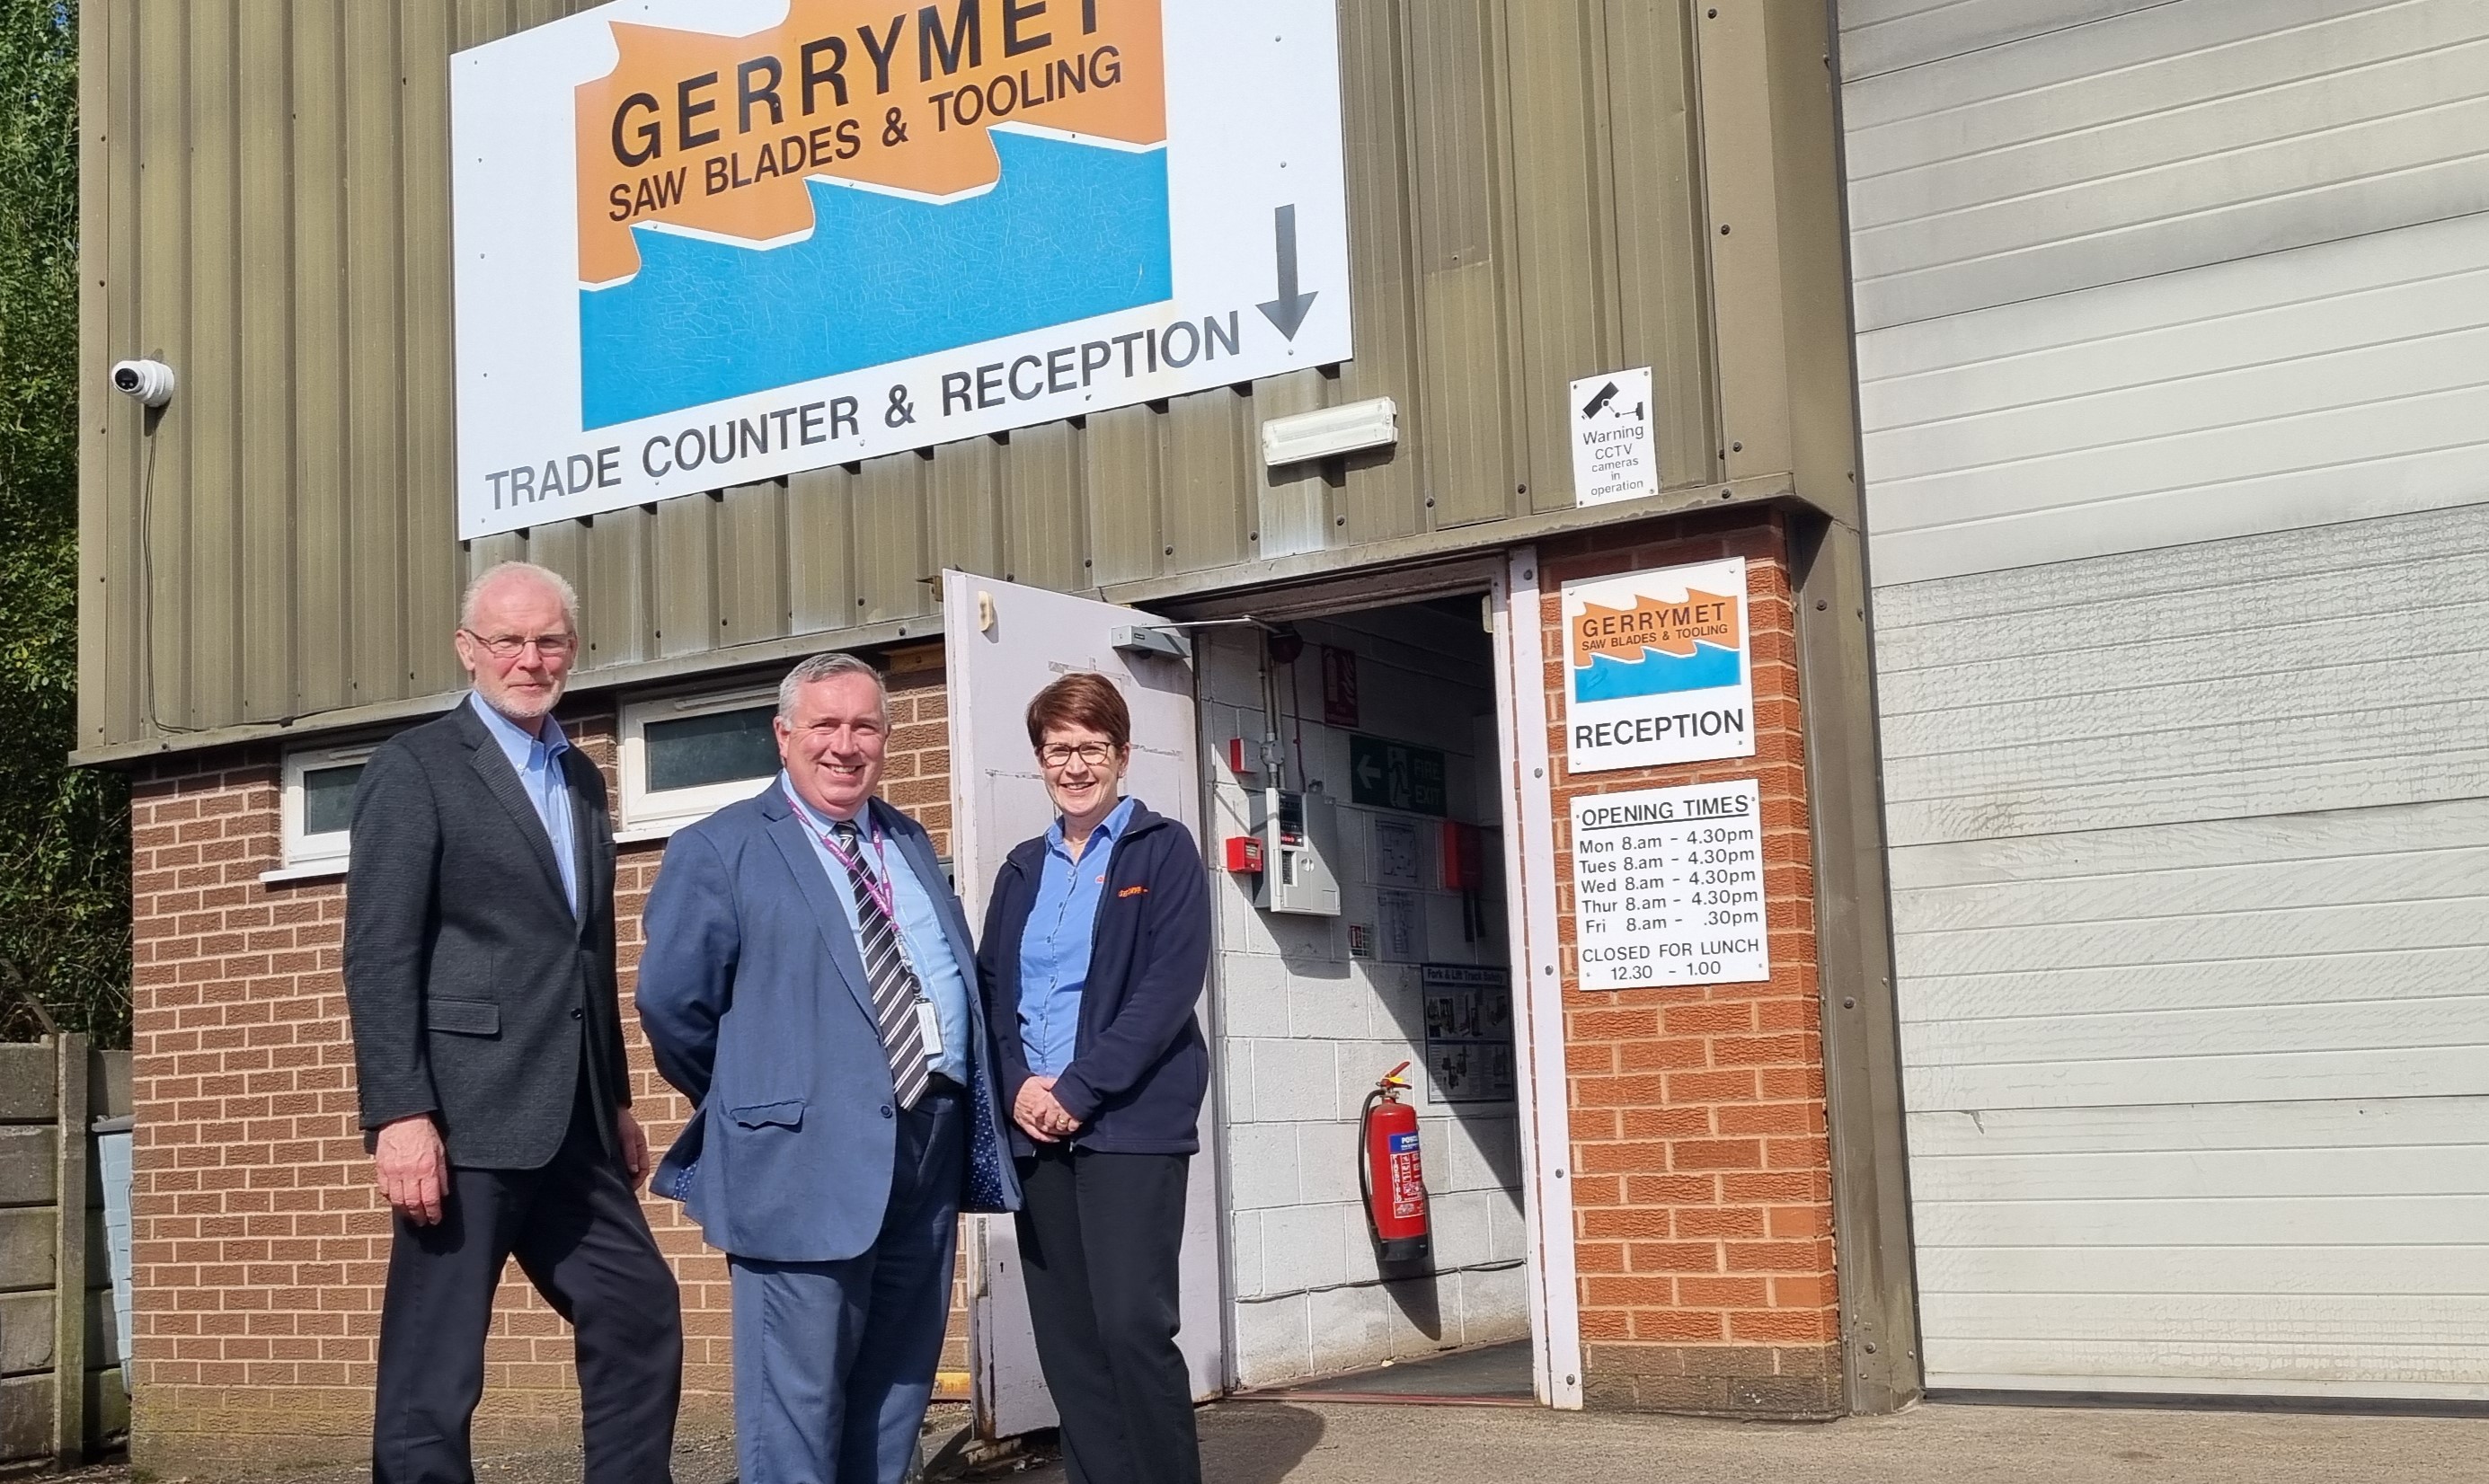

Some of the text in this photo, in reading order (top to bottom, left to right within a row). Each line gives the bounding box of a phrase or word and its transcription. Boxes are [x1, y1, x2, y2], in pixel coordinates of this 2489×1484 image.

[608, 46, 1121, 222] SAW BLADES & TOOLING
[485, 311, 1240, 510] TRADE COUNTER & RECEPTION
[1583, 426, 1644, 445] Warning
[1595, 443, 1633, 460] CCTV
[1591, 458, 1639, 473] cameras
[1611, 471, 1620, 481] in
[1590, 480, 1643, 497] operation
[1582, 602, 1726, 638] GERRYMET
[1581, 623, 1728, 651] SAW BLADES & TOOLING
[1575, 708, 1744, 748] RECEPTION
[1581, 794, 1749, 826] OPENING TIMES
[1579, 840, 1614, 854] Mon
[1622, 836, 1662, 851] 8.am
[1687, 828, 1754, 844] 4.30pm
[1579, 860, 1617, 874] Tues
[1623, 856, 1663, 870] 8.am
[1687, 849, 1755, 866] 4.30pm
[1581, 879, 1617, 894] Wed
[1625, 877, 1664, 890] 8.am
[1688, 869, 1756, 886] 4.30pm
[1581, 899, 1617, 914] Thur
[1625, 897, 1667, 911] 8.am
[1691, 889, 1758, 906] 4.30pm
[1585, 919, 1606, 933] Fri
[1626, 917, 1667, 932] 8.am
[1582, 939, 1759, 962] CLOSED FOR LUNCH
[1428, 968, 1443, 979] Fork
[1610, 966, 1652, 981] 12.30
[1686, 961, 1722, 976] 1.00
